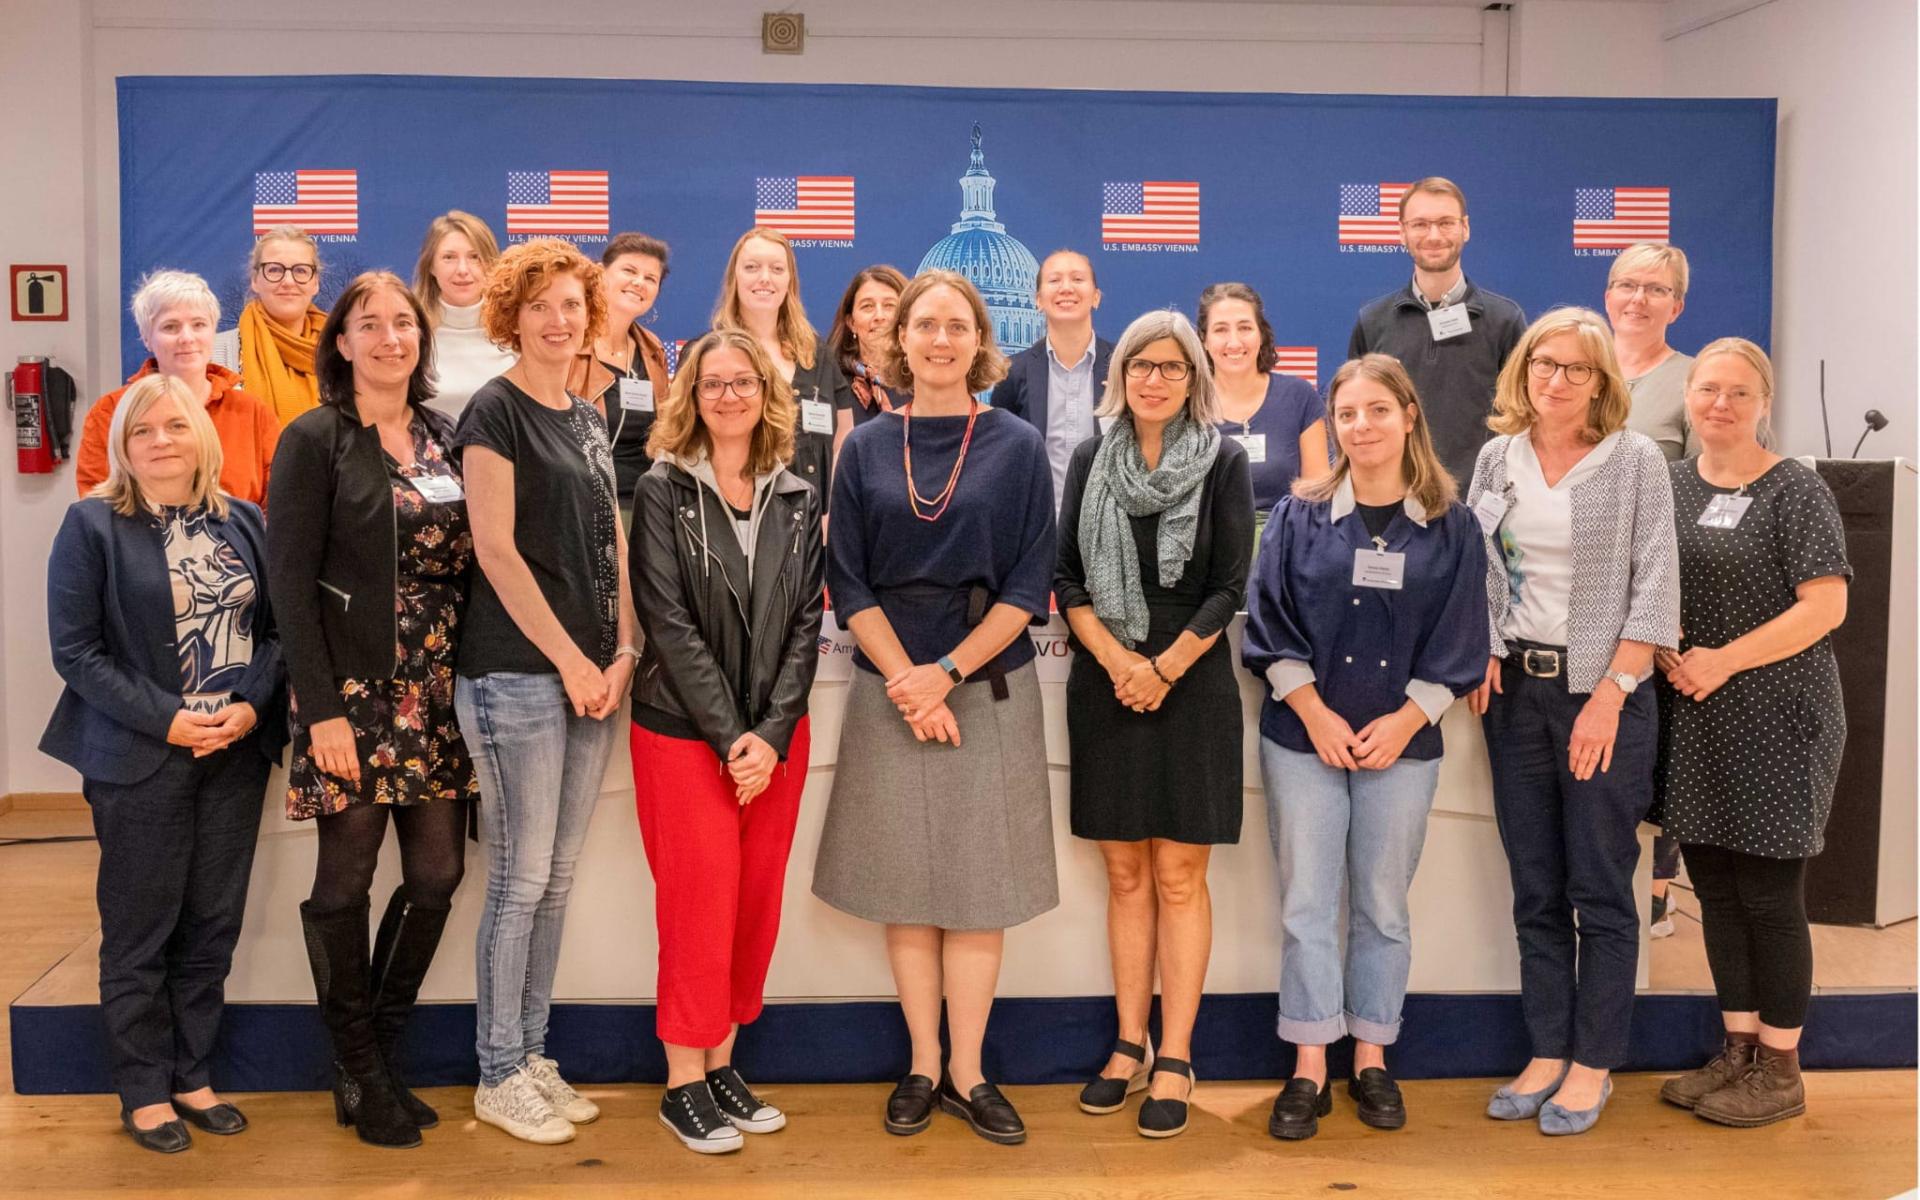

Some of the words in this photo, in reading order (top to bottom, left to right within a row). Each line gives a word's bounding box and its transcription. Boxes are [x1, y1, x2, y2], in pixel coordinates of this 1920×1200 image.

[320, 234, 357, 243] VIENNA
[508, 234, 526, 242] U.S.
[572, 234, 608, 243] VIENNA
[789, 239, 817, 248] BASSY
[819, 239, 854, 248] VIENNA
[1103, 243, 1120, 251] U.S.
[1122, 243, 1163, 252] EMBASSY
[1164, 244, 1199, 252] VIENNA
[1340, 244, 1356, 252] U.S.
[1358, 245, 1398, 253] EMBASSY
[1574, 248, 1590, 256] U.S.
